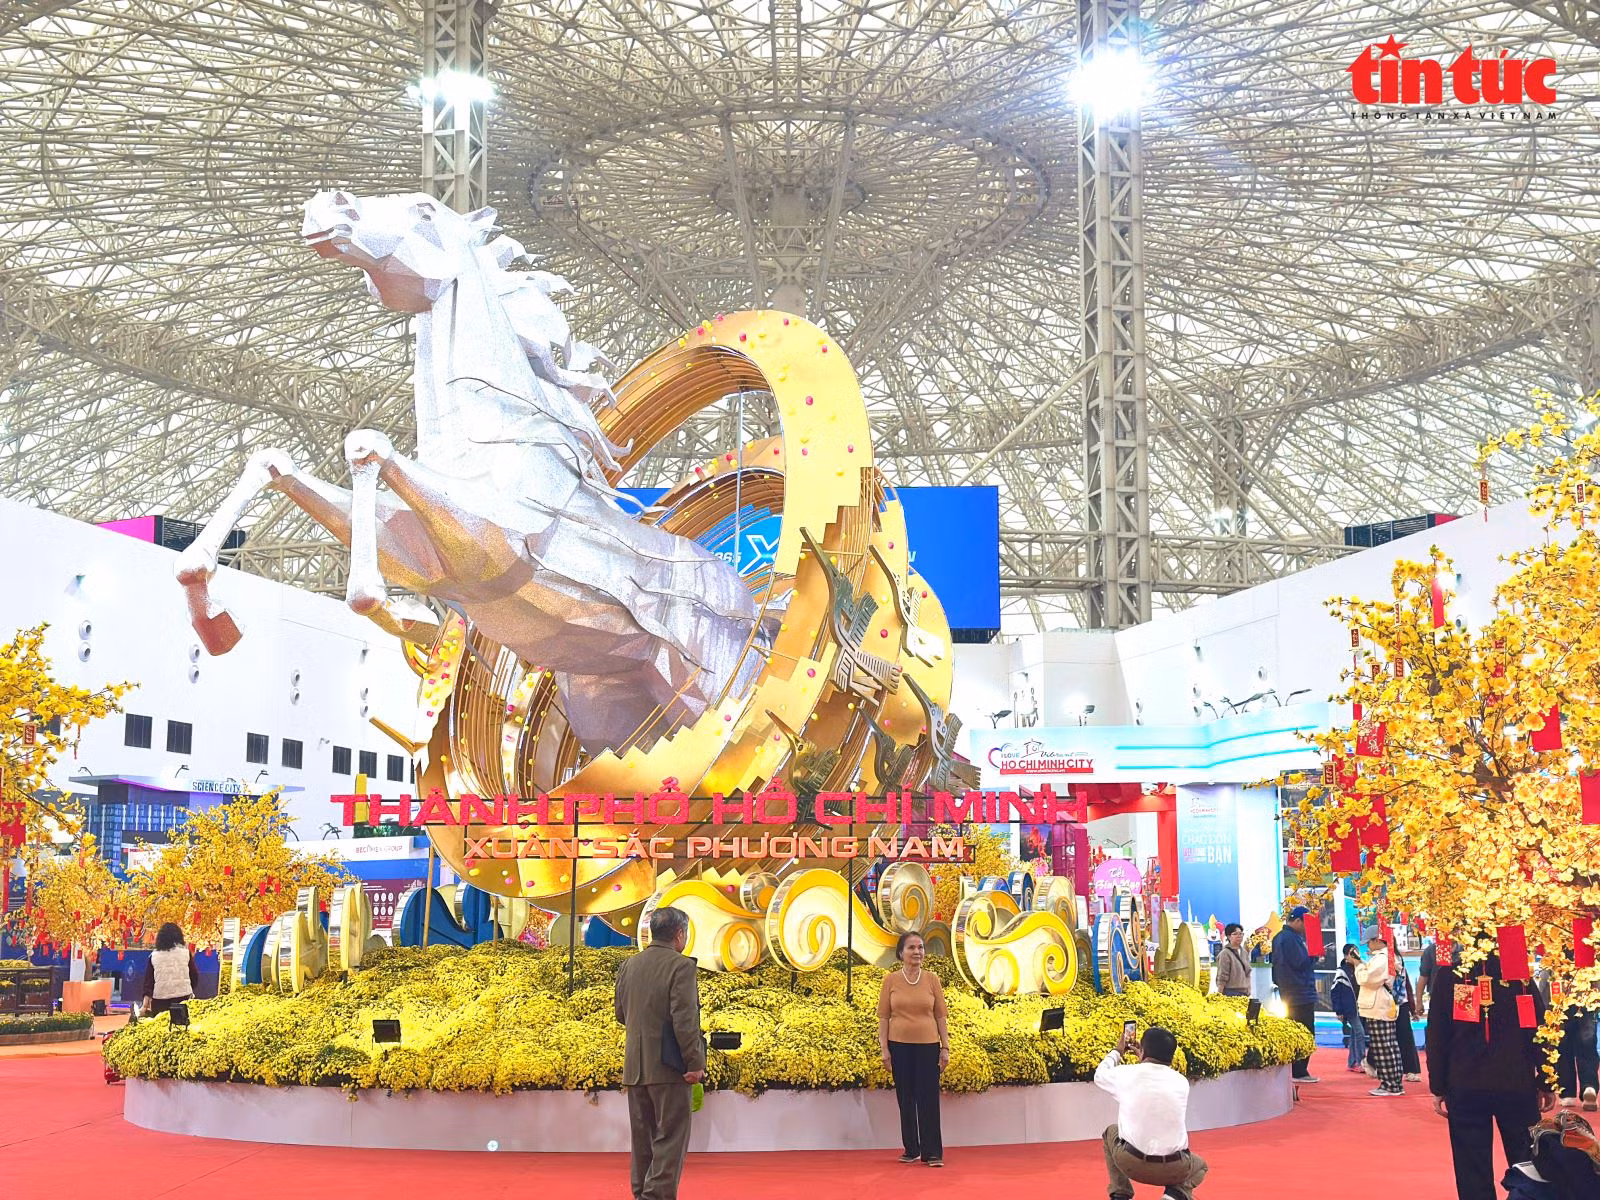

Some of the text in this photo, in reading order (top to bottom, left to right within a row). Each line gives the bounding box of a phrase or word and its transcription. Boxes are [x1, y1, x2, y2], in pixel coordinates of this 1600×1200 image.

[1002, 758, 1094, 770] HO CHI MINH CITY
[192, 781, 241, 794] SCIENCE CITY
[815, 782, 912, 825] CHÍ
[934, 791, 1088, 825] MINH
[463, 828, 964, 859] XUÂN SẮC PHƯƠNG NAM
[1208, 846, 1232, 868] BẠN
